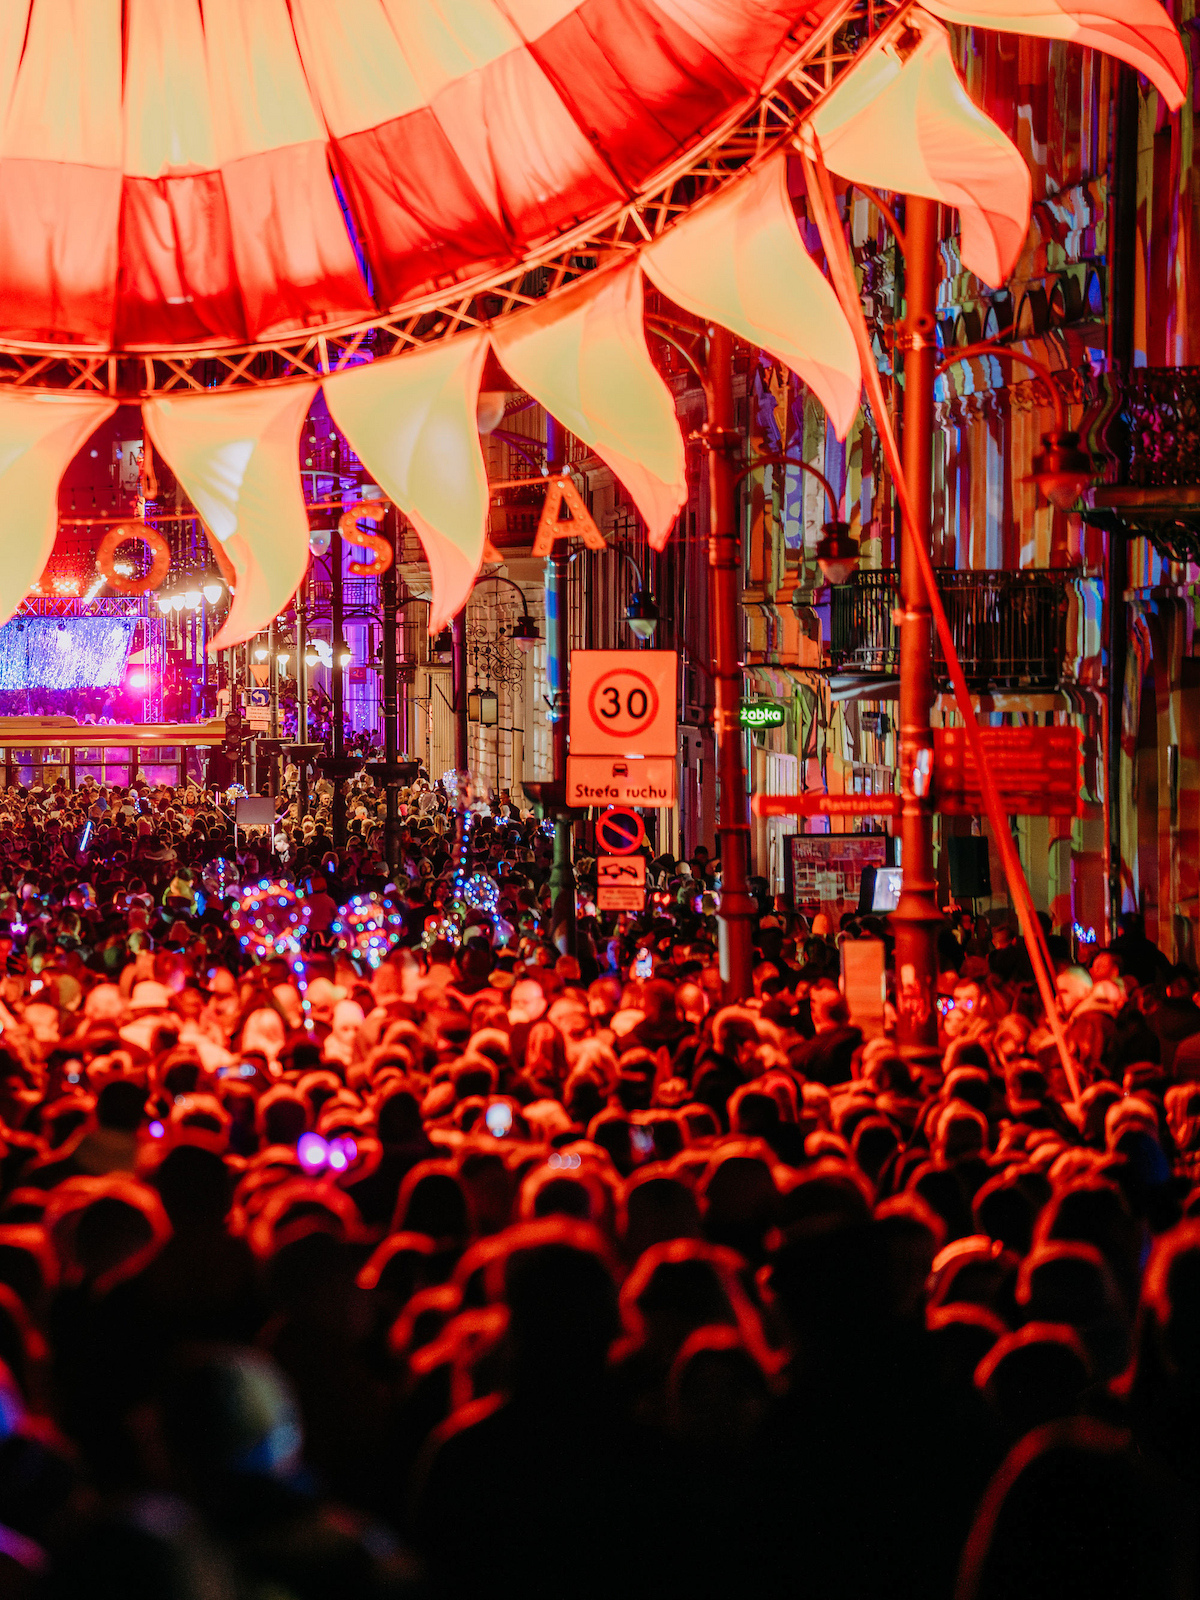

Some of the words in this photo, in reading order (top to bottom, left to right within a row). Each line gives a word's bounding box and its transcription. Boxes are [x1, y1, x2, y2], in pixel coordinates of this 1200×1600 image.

[600, 687, 647, 719] 30
[740, 707, 781, 721] żabka
[575, 784, 619, 799] Strefa
[626, 785, 667, 799] ruchu
